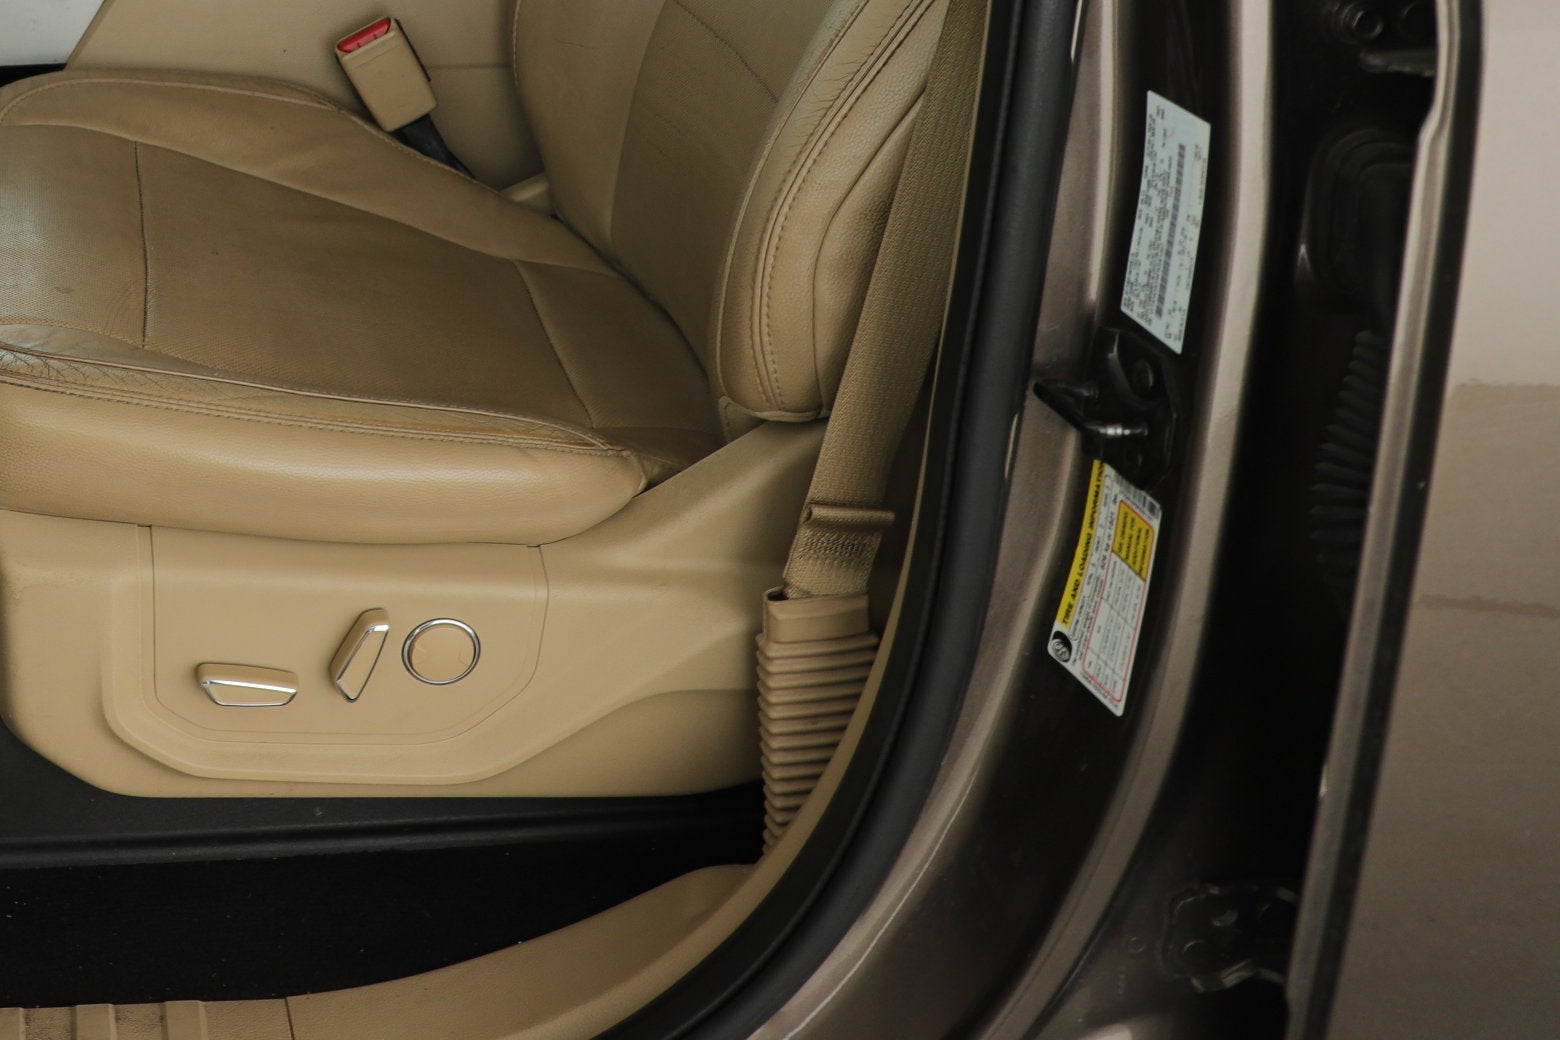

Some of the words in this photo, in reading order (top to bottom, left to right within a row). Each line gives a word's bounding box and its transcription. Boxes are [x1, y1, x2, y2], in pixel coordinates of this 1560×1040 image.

[1061, 600, 1073, 626] TIRE
[1070, 578, 1081, 601] AND
[1077, 533, 1091, 577] LOADING
